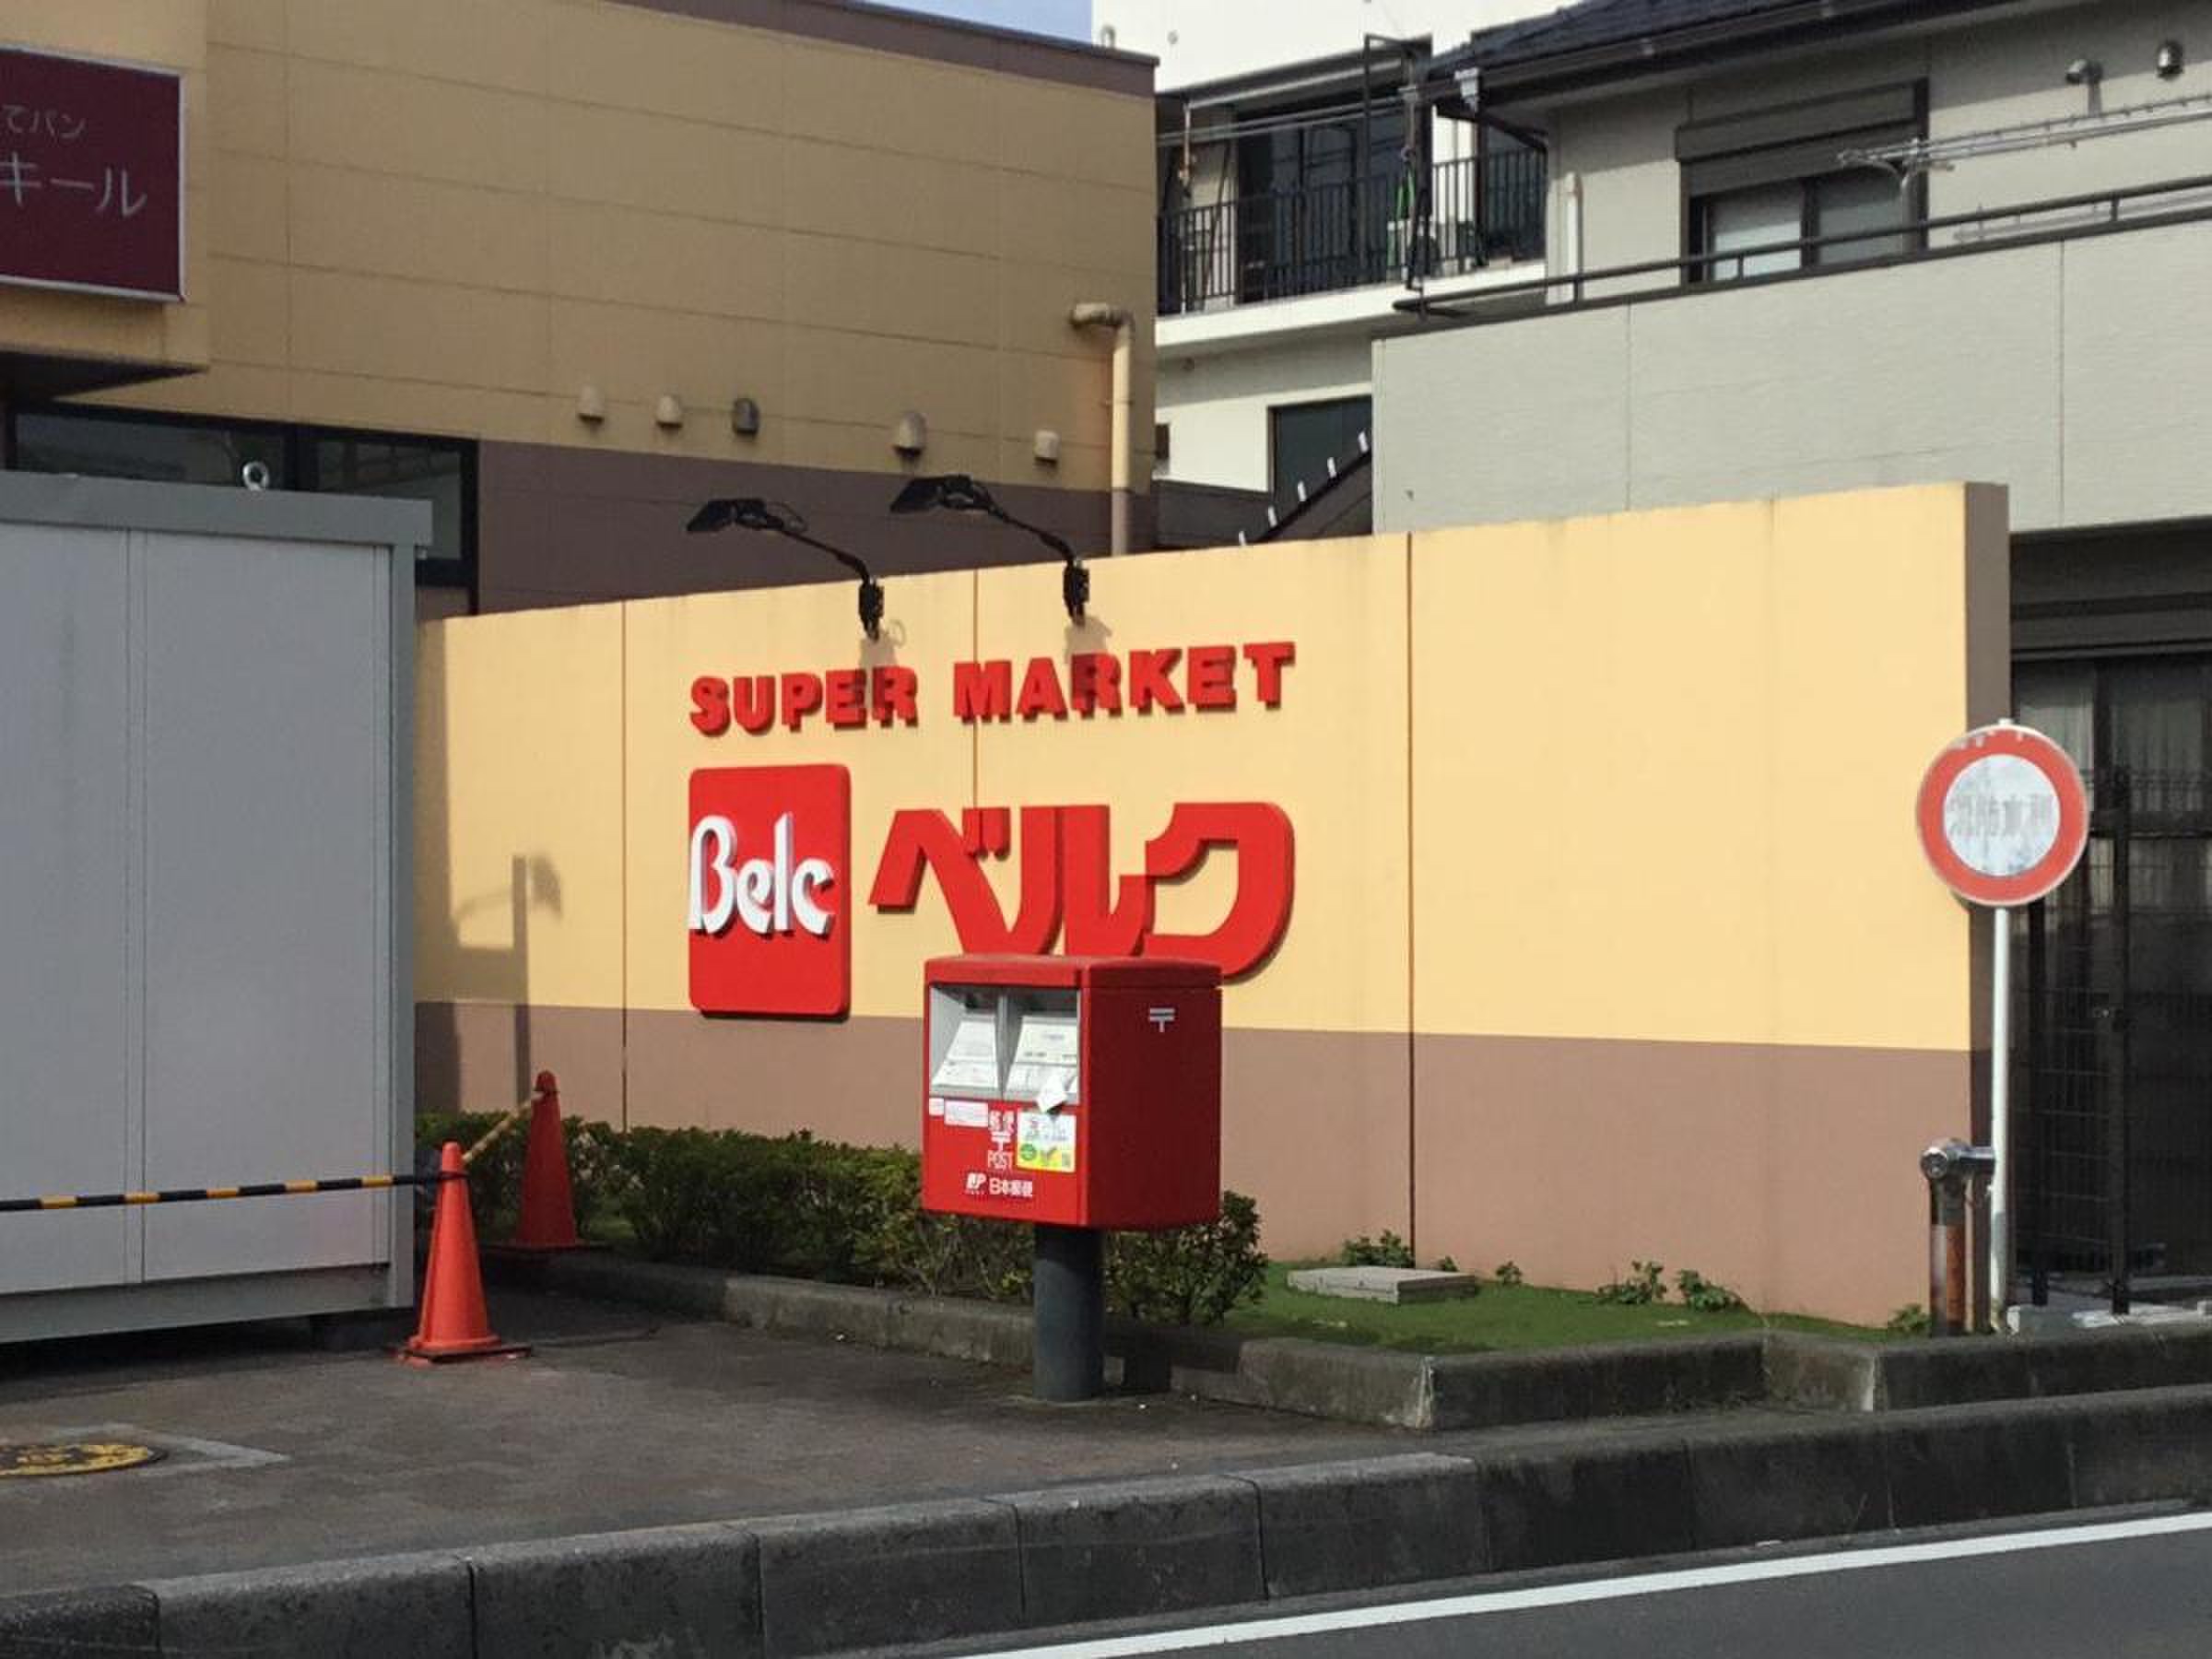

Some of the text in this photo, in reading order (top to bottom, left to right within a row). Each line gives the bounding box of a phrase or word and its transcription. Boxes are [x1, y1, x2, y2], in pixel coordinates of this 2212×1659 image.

[0, 150, 147, 218] キール
[690, 641, 1296, 737] SUPER MARKET
[688, 811, 834, 936] Belc
[868, 802, 1295, 982] ベルク
